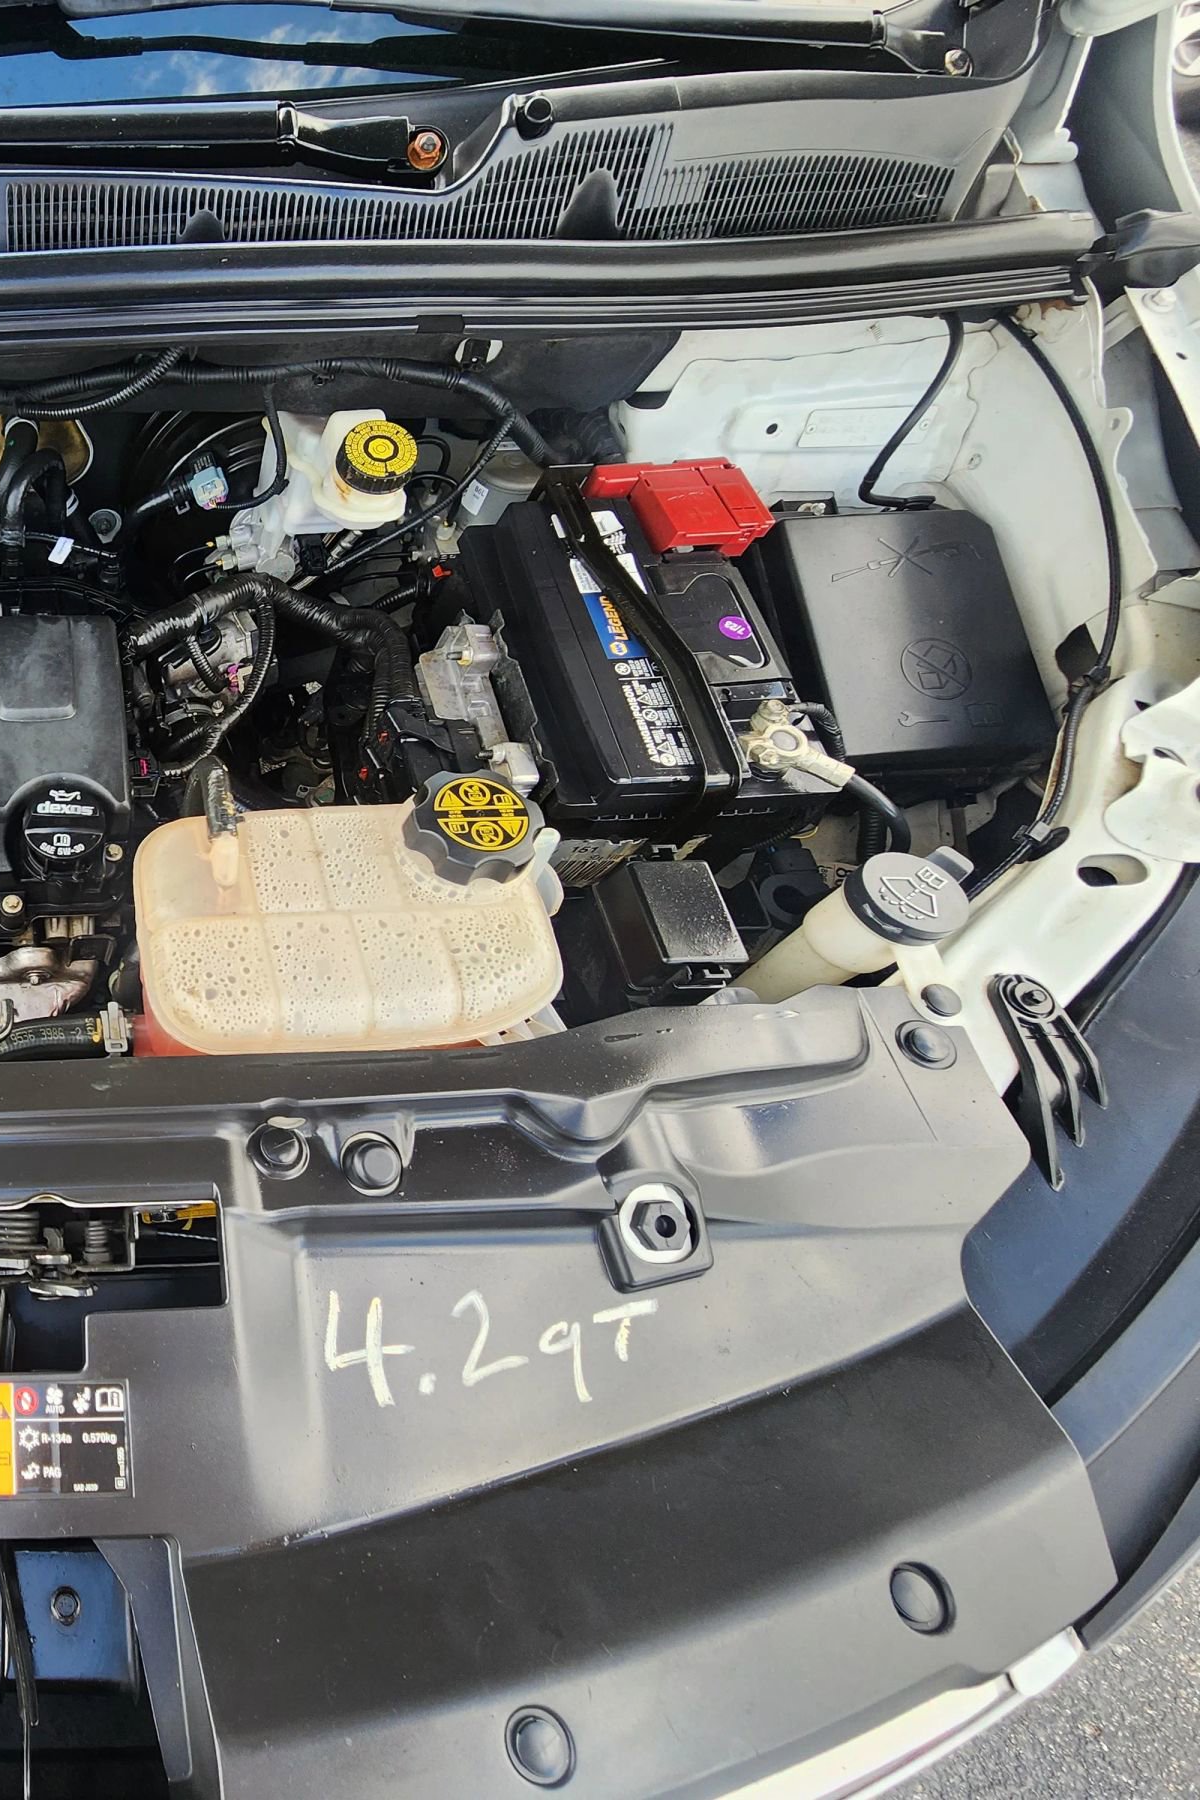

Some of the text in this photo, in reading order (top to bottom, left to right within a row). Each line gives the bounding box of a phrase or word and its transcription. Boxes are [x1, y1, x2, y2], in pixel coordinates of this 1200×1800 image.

[37, 801, 95, 816] dexos
[45, 1405, 64, 1414] AUTO
[41, 1433, 72, 1444] R-134a
